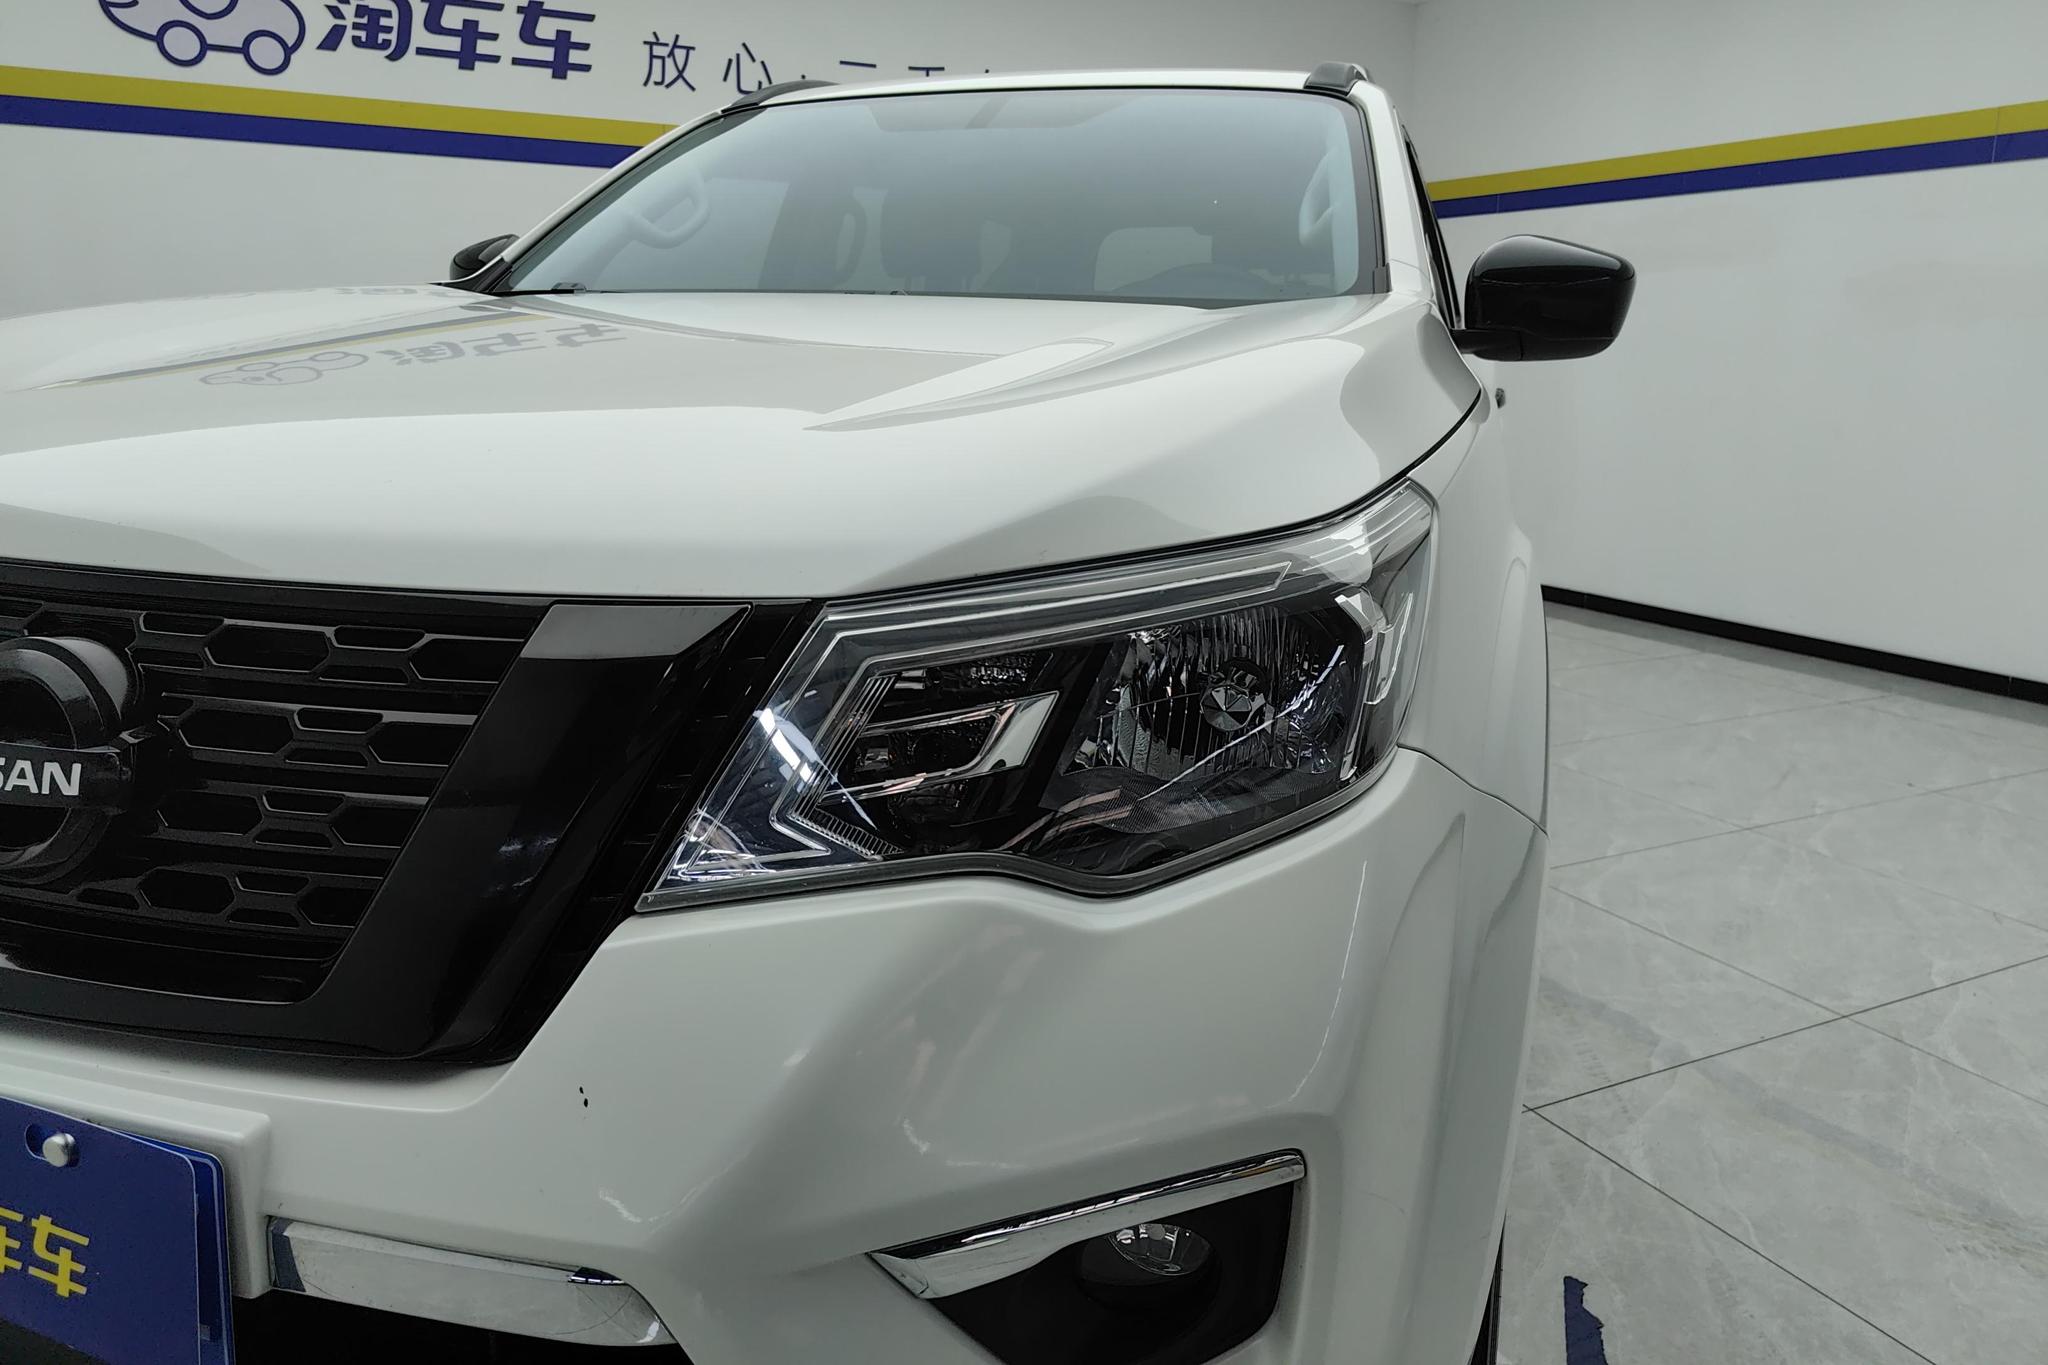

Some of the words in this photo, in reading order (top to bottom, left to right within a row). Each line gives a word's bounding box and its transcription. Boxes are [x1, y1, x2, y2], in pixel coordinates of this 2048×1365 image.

[316, 0, 596, 80] 淘车车
[0, 757, 82, 796] AN
